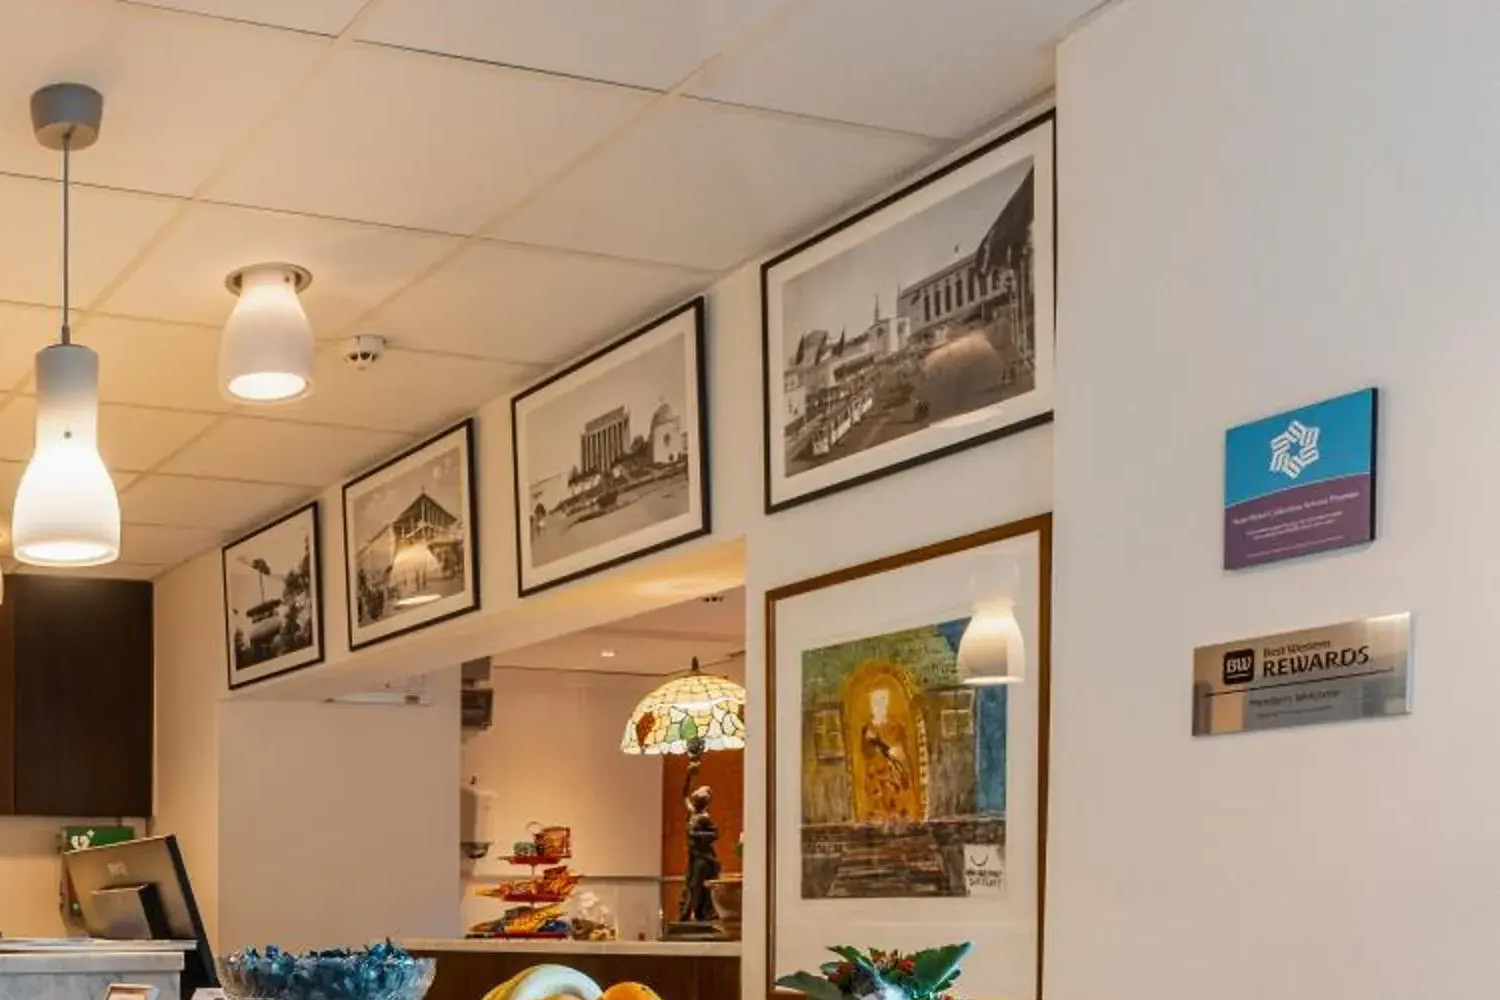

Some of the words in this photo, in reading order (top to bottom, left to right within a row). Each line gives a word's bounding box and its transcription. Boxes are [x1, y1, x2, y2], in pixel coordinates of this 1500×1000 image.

[1263, 645, 1286, 658] Best
[1226, 655, 1252, 673] BW
[1263, 646, 1369, 677] REWARDS
